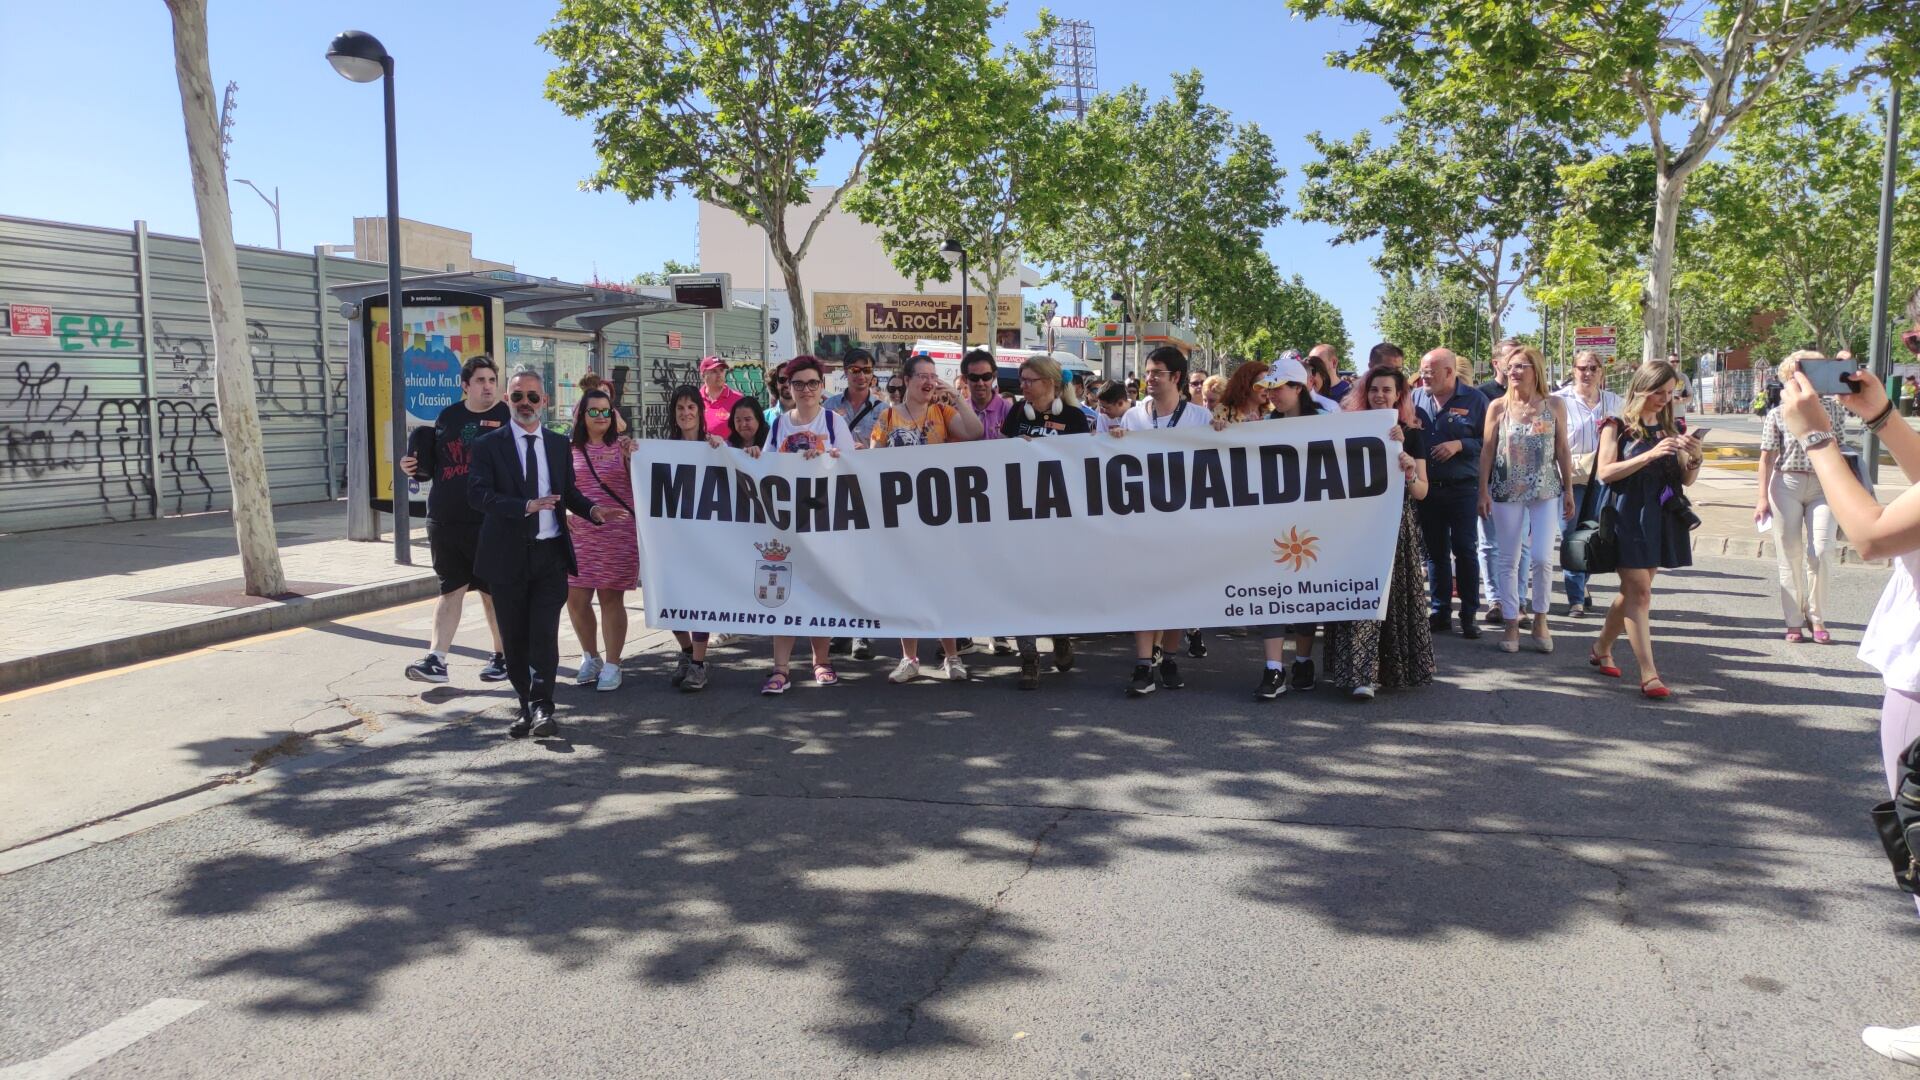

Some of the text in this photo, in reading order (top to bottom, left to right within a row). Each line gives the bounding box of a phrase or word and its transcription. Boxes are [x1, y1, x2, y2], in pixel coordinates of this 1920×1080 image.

[12, 306, 49, 314] PROHIBIDO
[891, 300, 948, 308] BIOPARQUE
[869, 308, 968, 330] LA ROCHA
[404, 372, 437, 387] ehículo
[410, 392, 452, 409] y Ocasión
[650, 436, 1389, 533] MARCHA POR LA IGUALDAD
[1225, 578, 1380, 599] Consejo Municipal
[1225, 597, 1381, 617] de la Discapacidad
[660, 609, 881, 629] AYUNTAMIENTO DE ALBACETE
